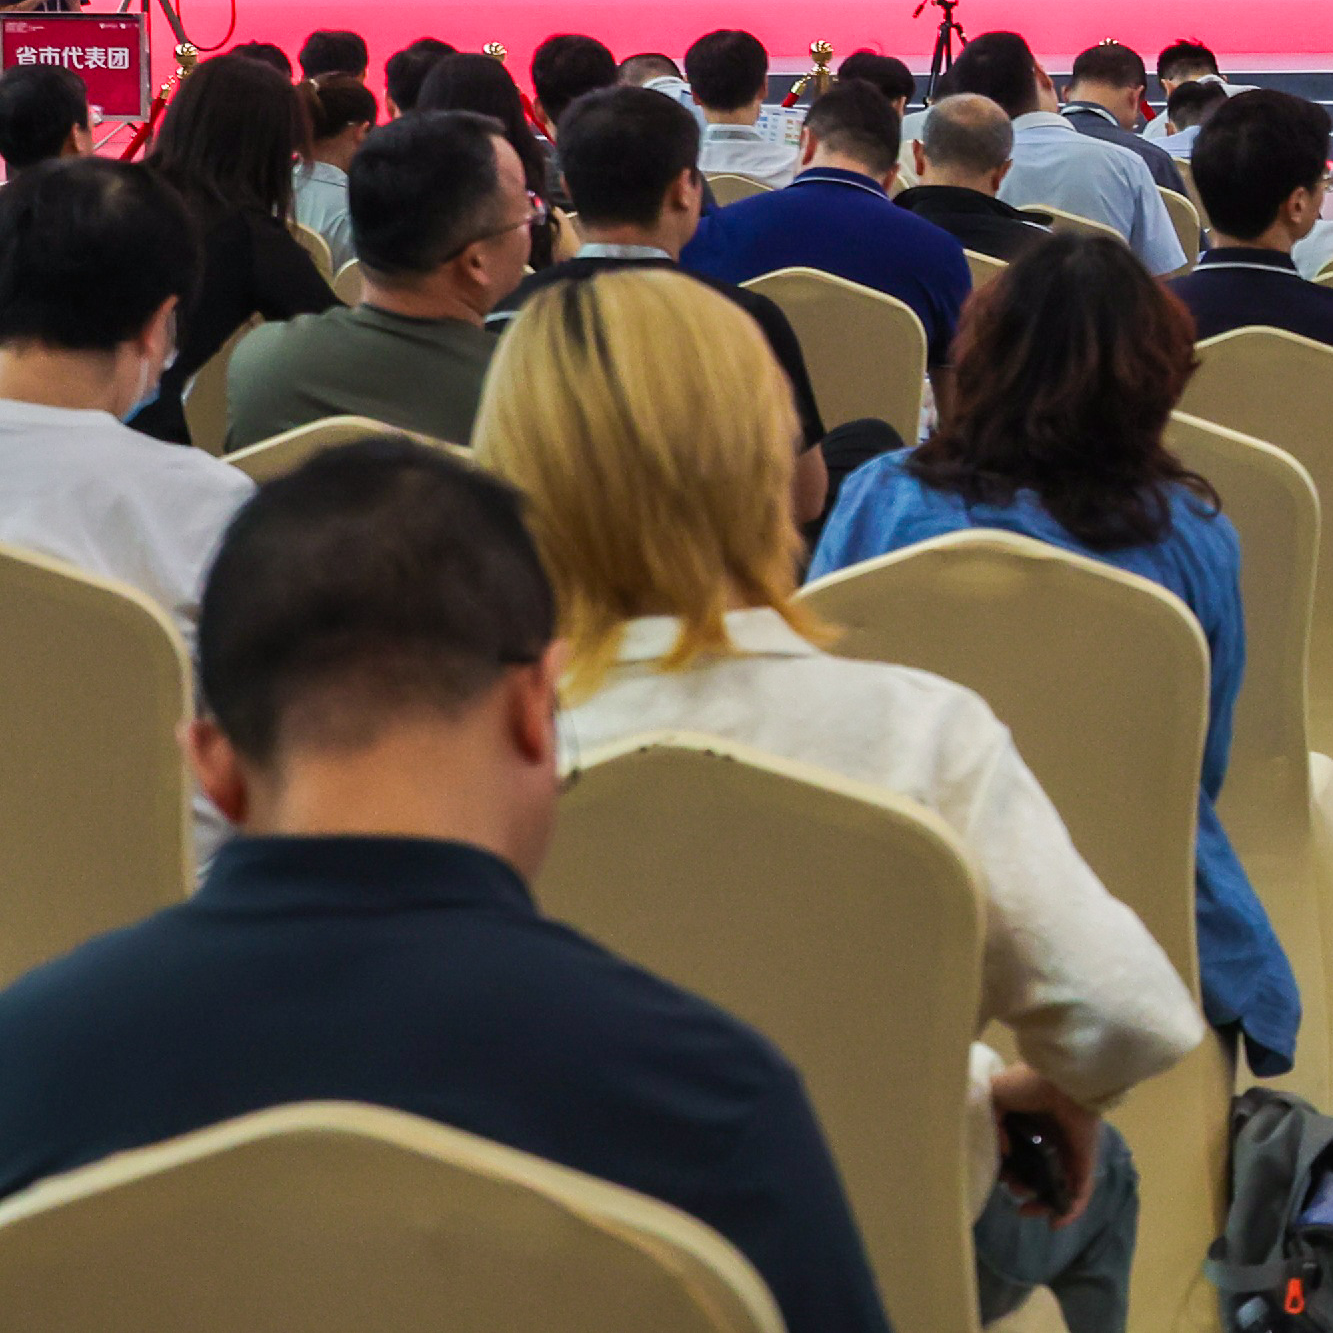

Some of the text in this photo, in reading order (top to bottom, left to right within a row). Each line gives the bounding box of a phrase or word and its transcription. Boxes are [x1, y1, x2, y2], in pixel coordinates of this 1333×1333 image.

[16, 45, 130, 69] 省市代表团
